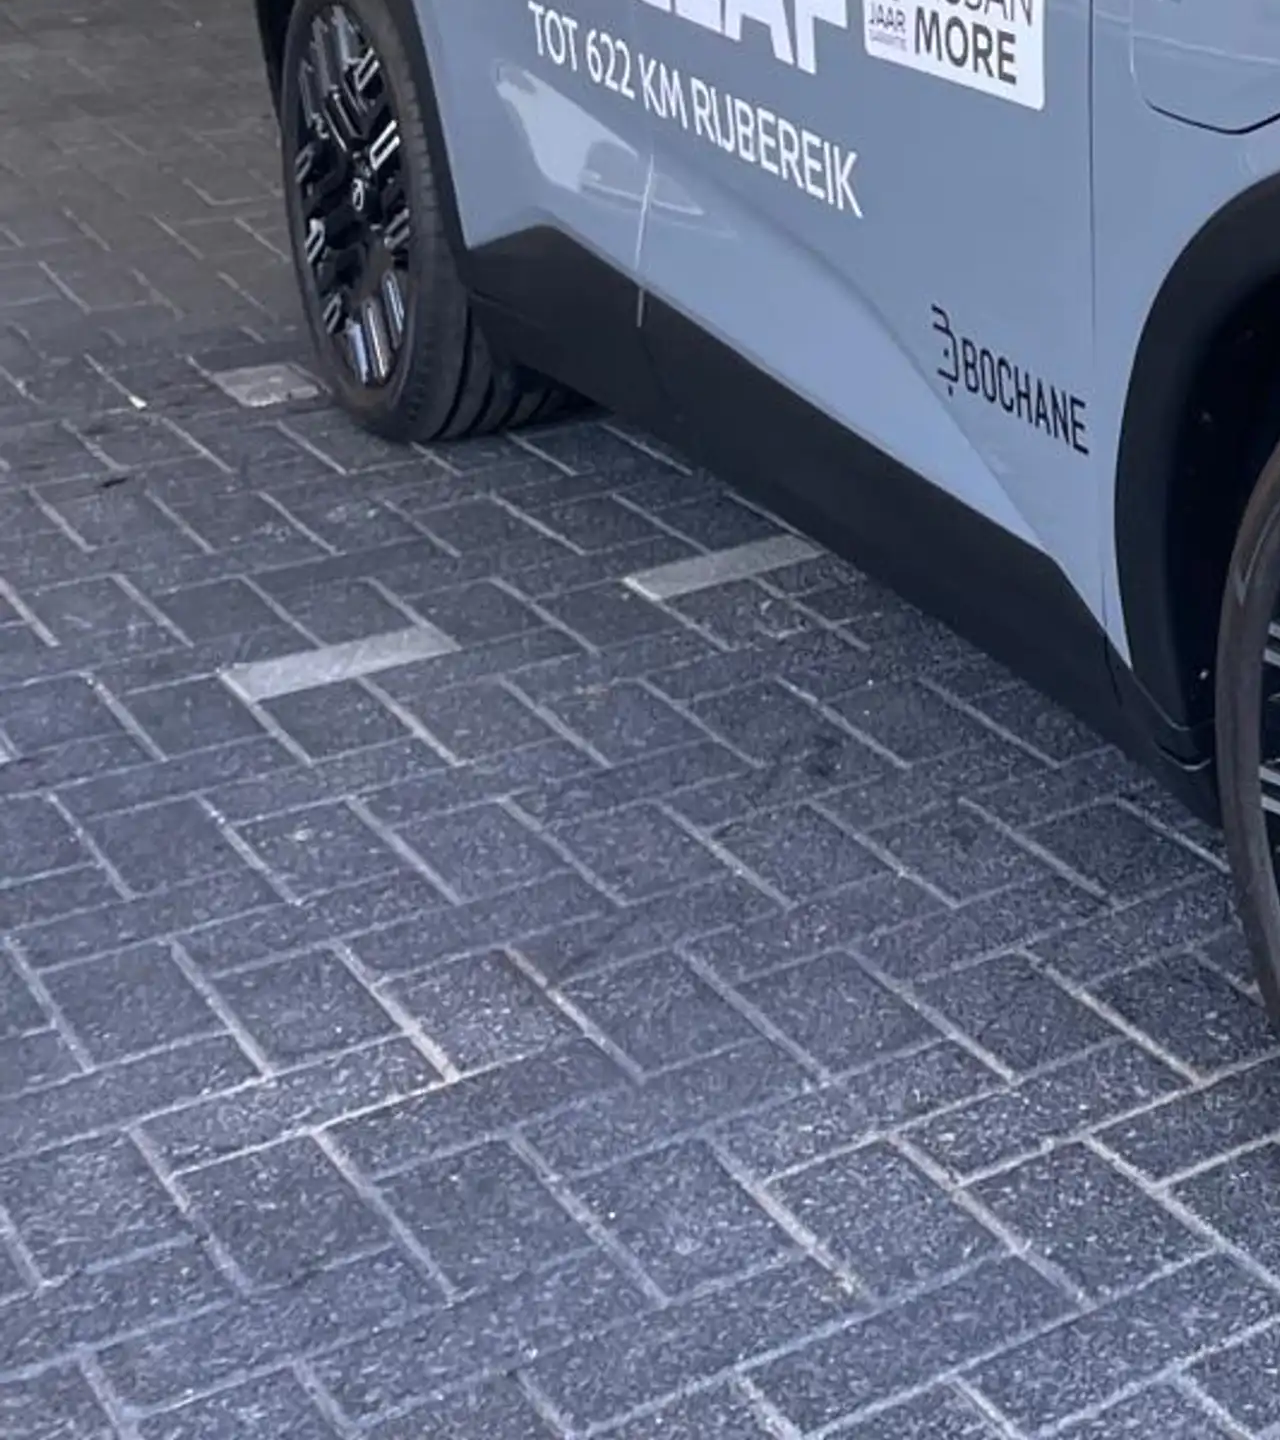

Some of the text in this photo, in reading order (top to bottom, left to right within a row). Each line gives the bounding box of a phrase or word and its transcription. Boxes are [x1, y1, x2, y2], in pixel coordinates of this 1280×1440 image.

[915, 6, 1017, 85] MORE
[528, 0, 863, 218] TOT 622 KM RIJBEREIK
[962, 337, 1089, 455] BOCHANE
